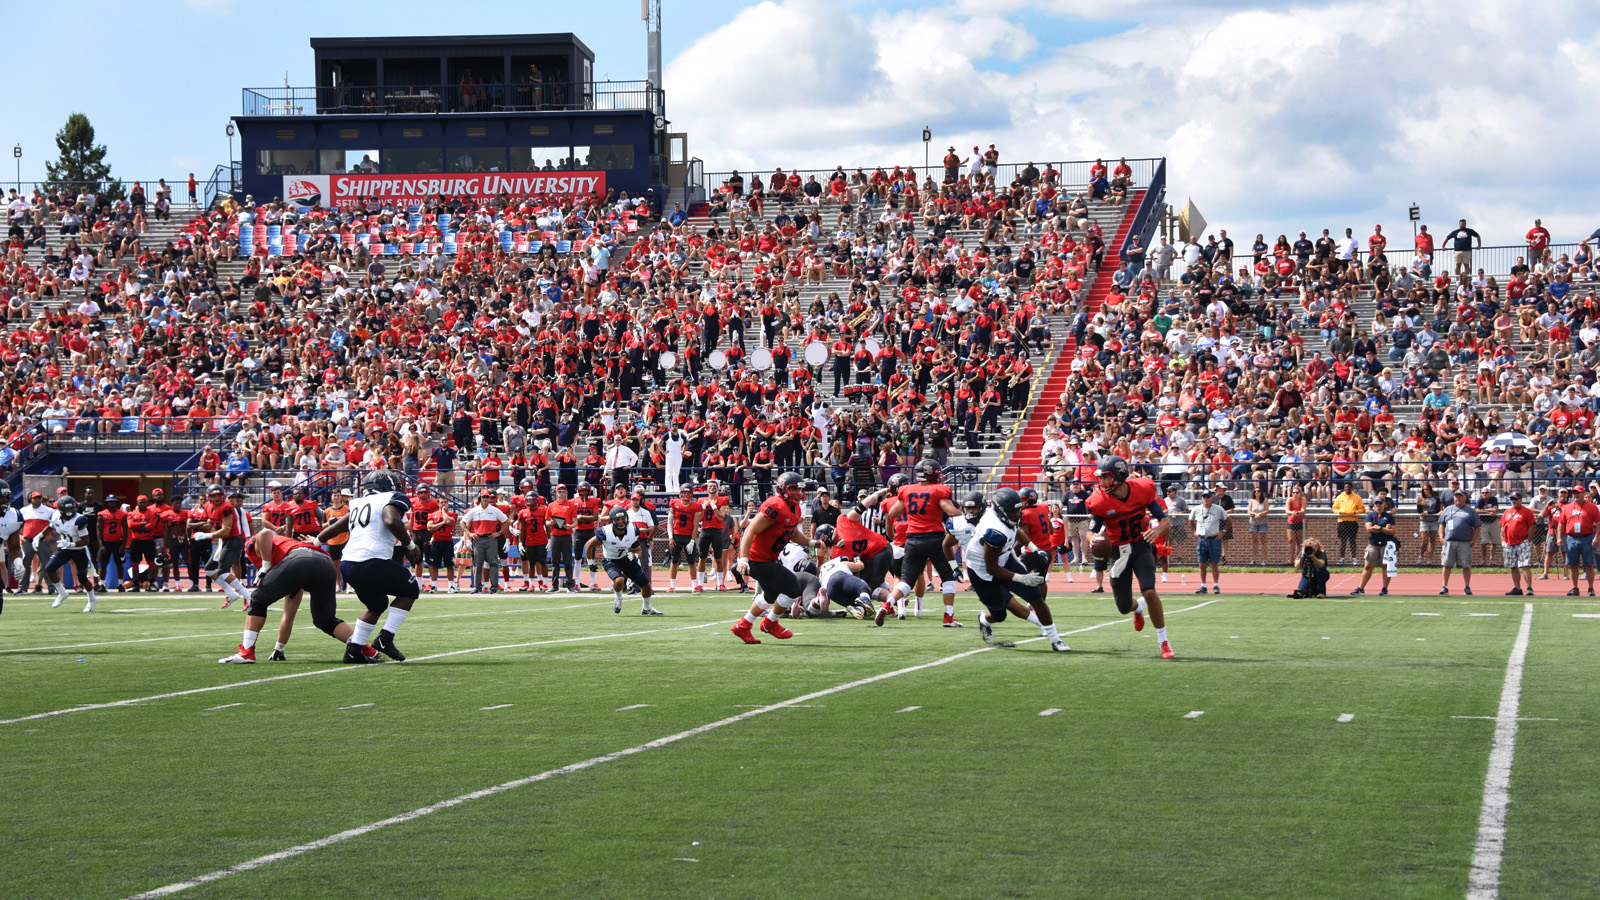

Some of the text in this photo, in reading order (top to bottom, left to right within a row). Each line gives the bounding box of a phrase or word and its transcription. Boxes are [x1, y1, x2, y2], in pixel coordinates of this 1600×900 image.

[226, 124, 235, 136] C
[656, 117, 664, 129] C
[922, 129, 932, 142] D
[13, 146, 23, 158] B
[1409, 206, 1420, 221] E
[908, 492, 931, 515] 67
[295, 511, 312, 526] 70
[530, 518, 538, 533] 3
[678, 513, 688, 528] 9
[1038, 513, 1049, 535] 5
[108, 521, 117, 535] 2
[1118, 512, 1143, 542] 16
[616, 549, 626, 559] 7
